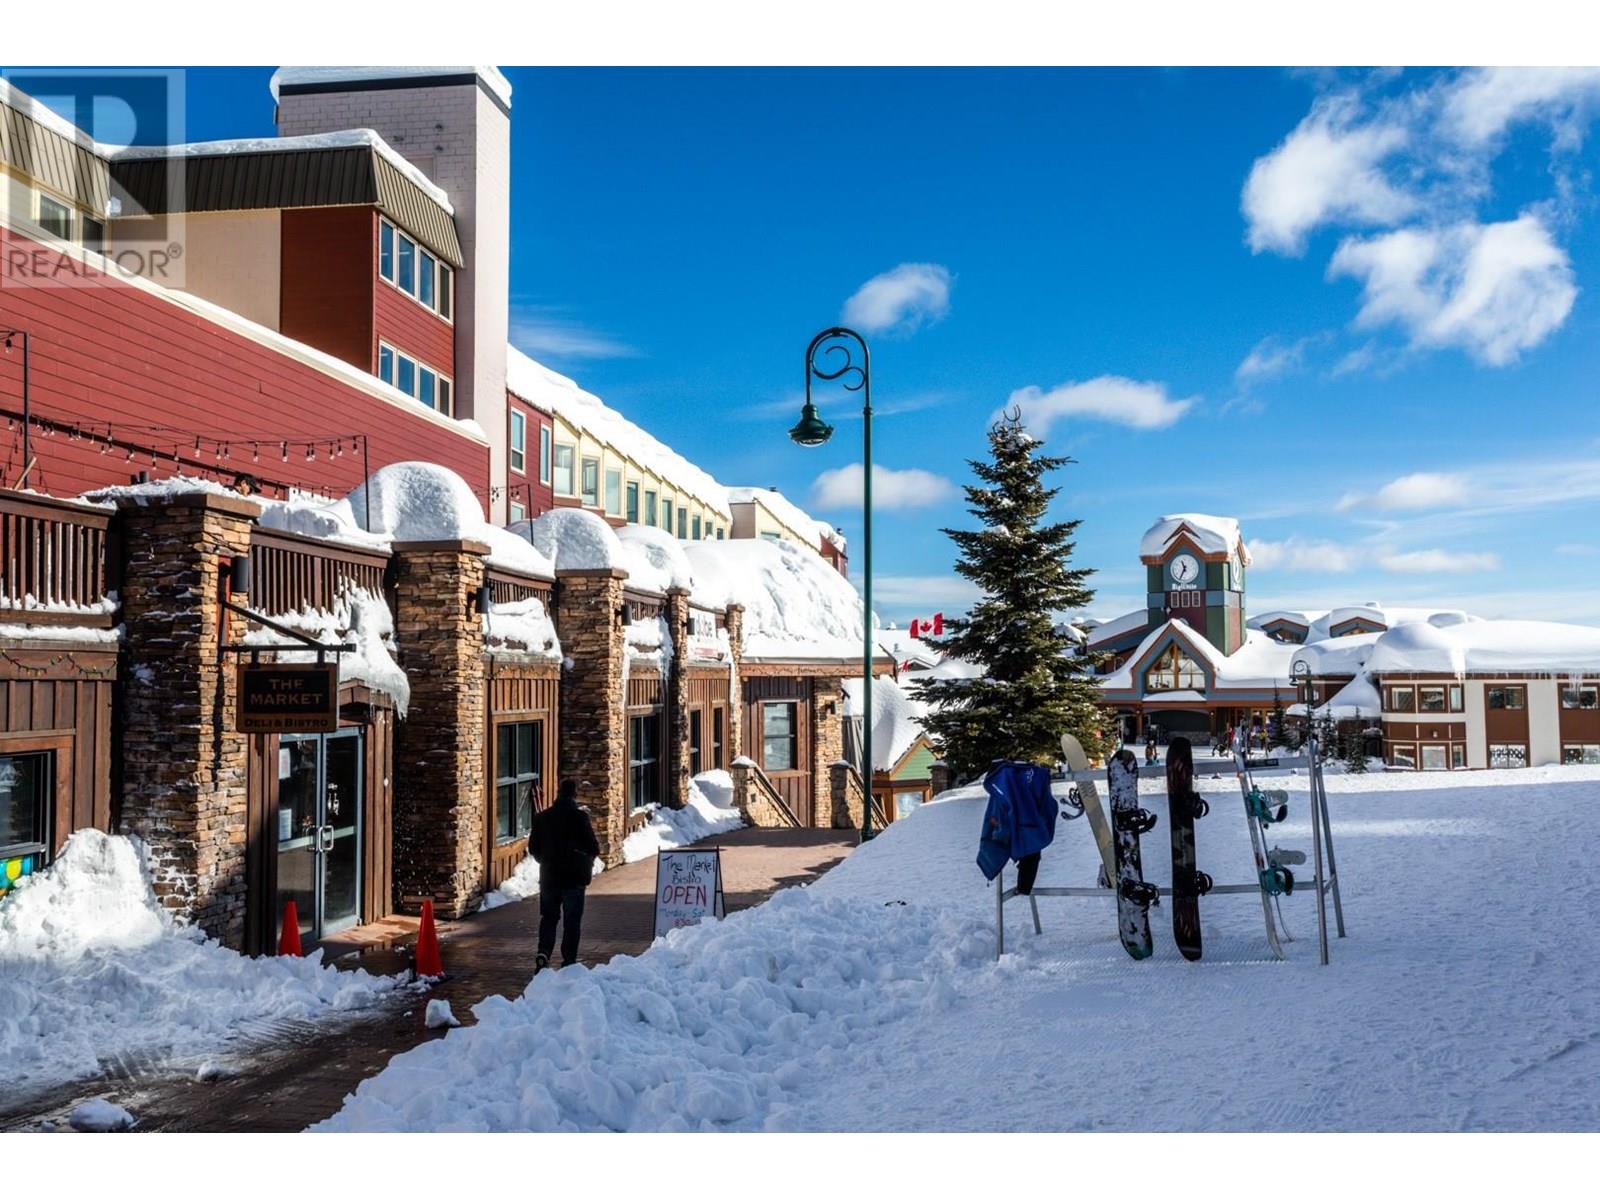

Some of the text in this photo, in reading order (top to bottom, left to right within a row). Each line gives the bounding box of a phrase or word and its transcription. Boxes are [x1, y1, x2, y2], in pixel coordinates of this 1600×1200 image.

[268, 678, 304, 689] THE
[250, 693, 323, 704] MARKET
[244, 718, 271, 727] DELI
[284, 718, 328, 728] BISTRO
[662, 854, 715, 877] The Market
[662, 885, 707, 907] OPEN
